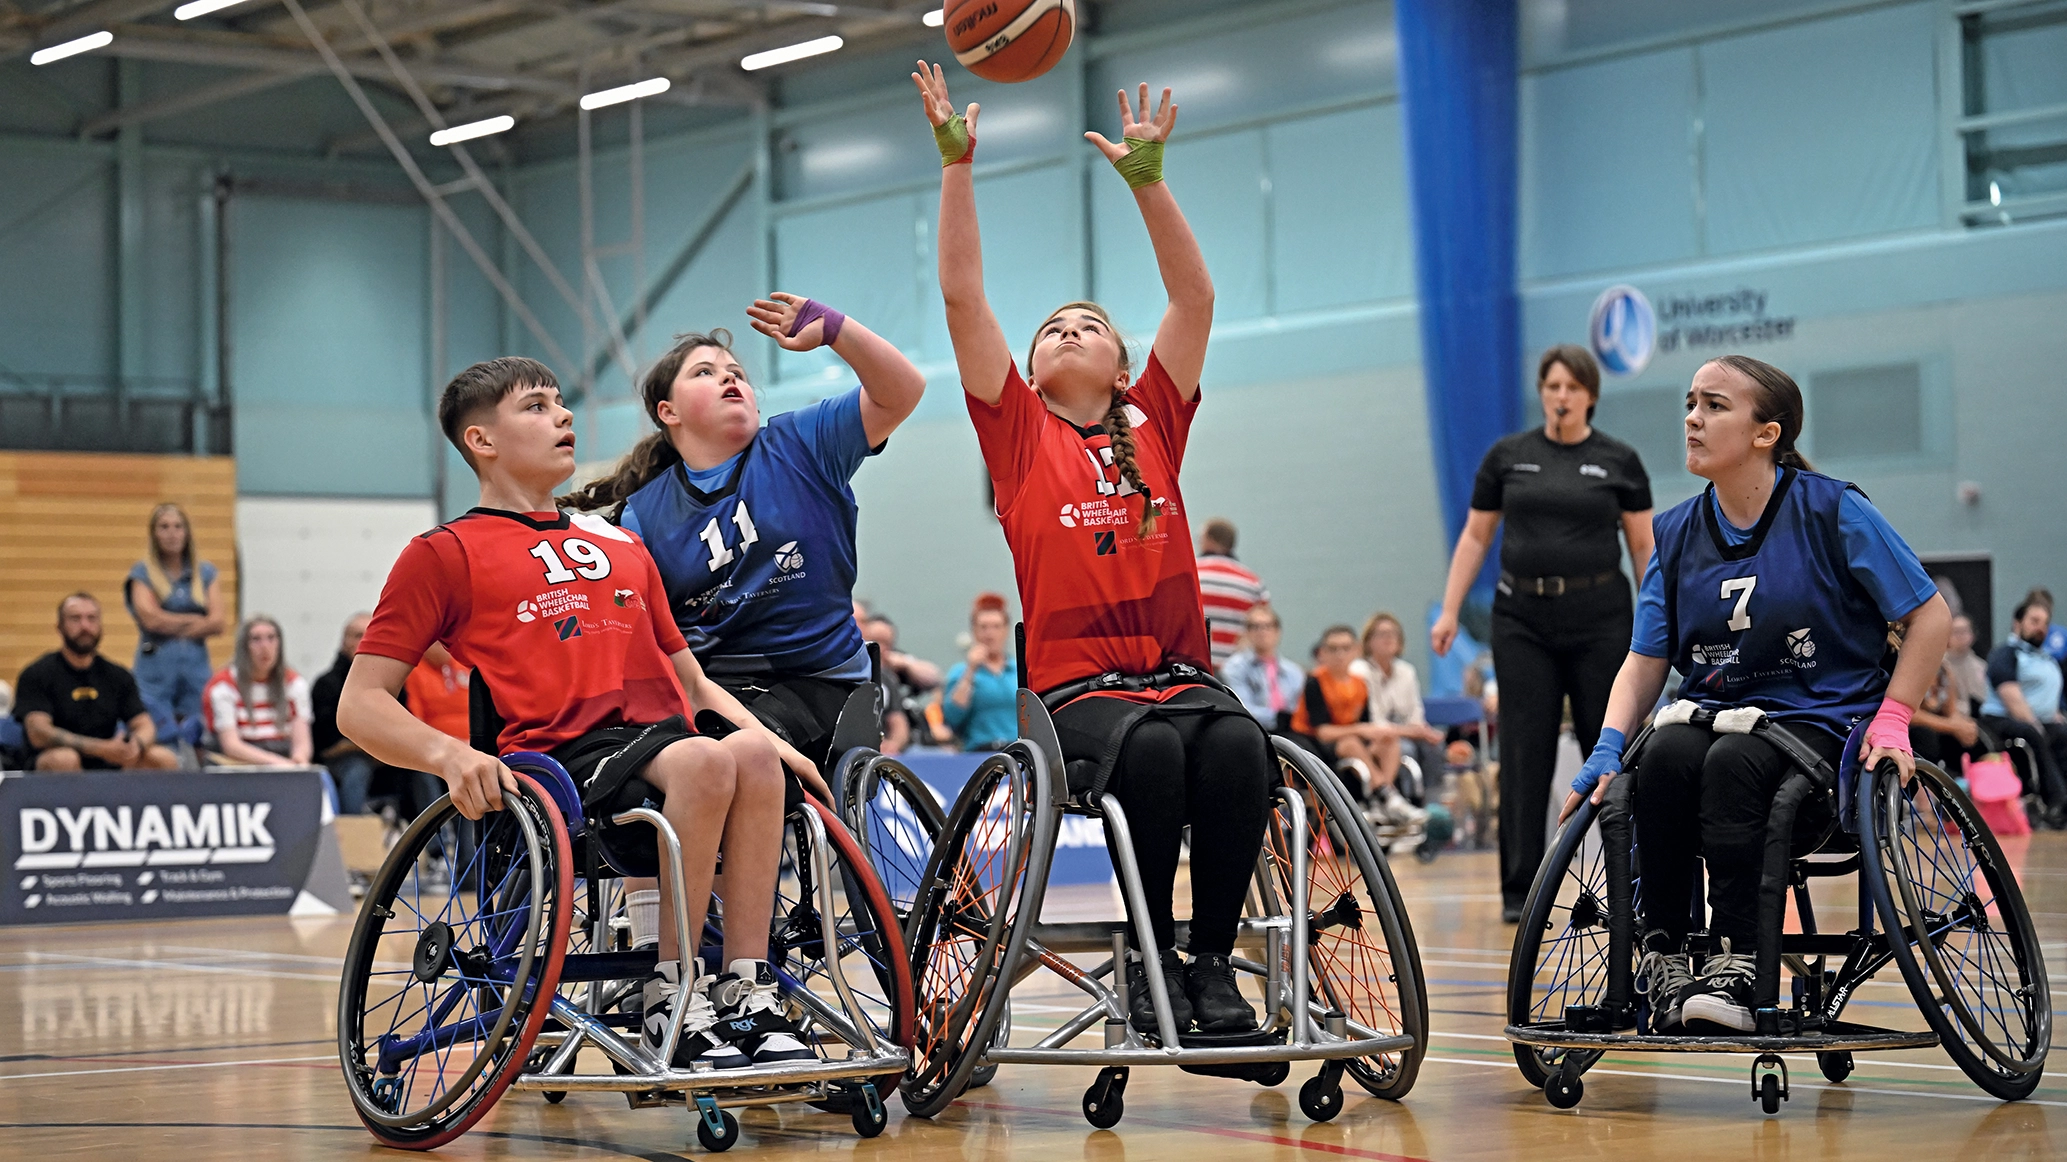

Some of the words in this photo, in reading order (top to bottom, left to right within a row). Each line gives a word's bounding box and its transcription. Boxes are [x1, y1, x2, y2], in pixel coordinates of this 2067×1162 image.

[1657, 286, 1768, 324] University
[1658, 328, 1682, 353] of
[1685, 317, 1796, 348] Worcester
[698, 498, 760, 573] 11
[528, 537, 612, 586] 19
[768, 571, 807, 585] SCOTLAND
[536, 587, 569, 603] BRITISH
[538, 593, 588, 610] WHEELCHAIR
[1720, 575, 1757, 632] 7
[541, 601, 591, 618] BASKETBALL
[1704, 642, 1731, 652] BRITISH
[1779, 657, 1818, 670] SCOTLAND
[19, 802, 276, 853] DYNAMIK
[1707, 976, 1739, 989] RGK
[729, 1017, 758, 1032] RGK
